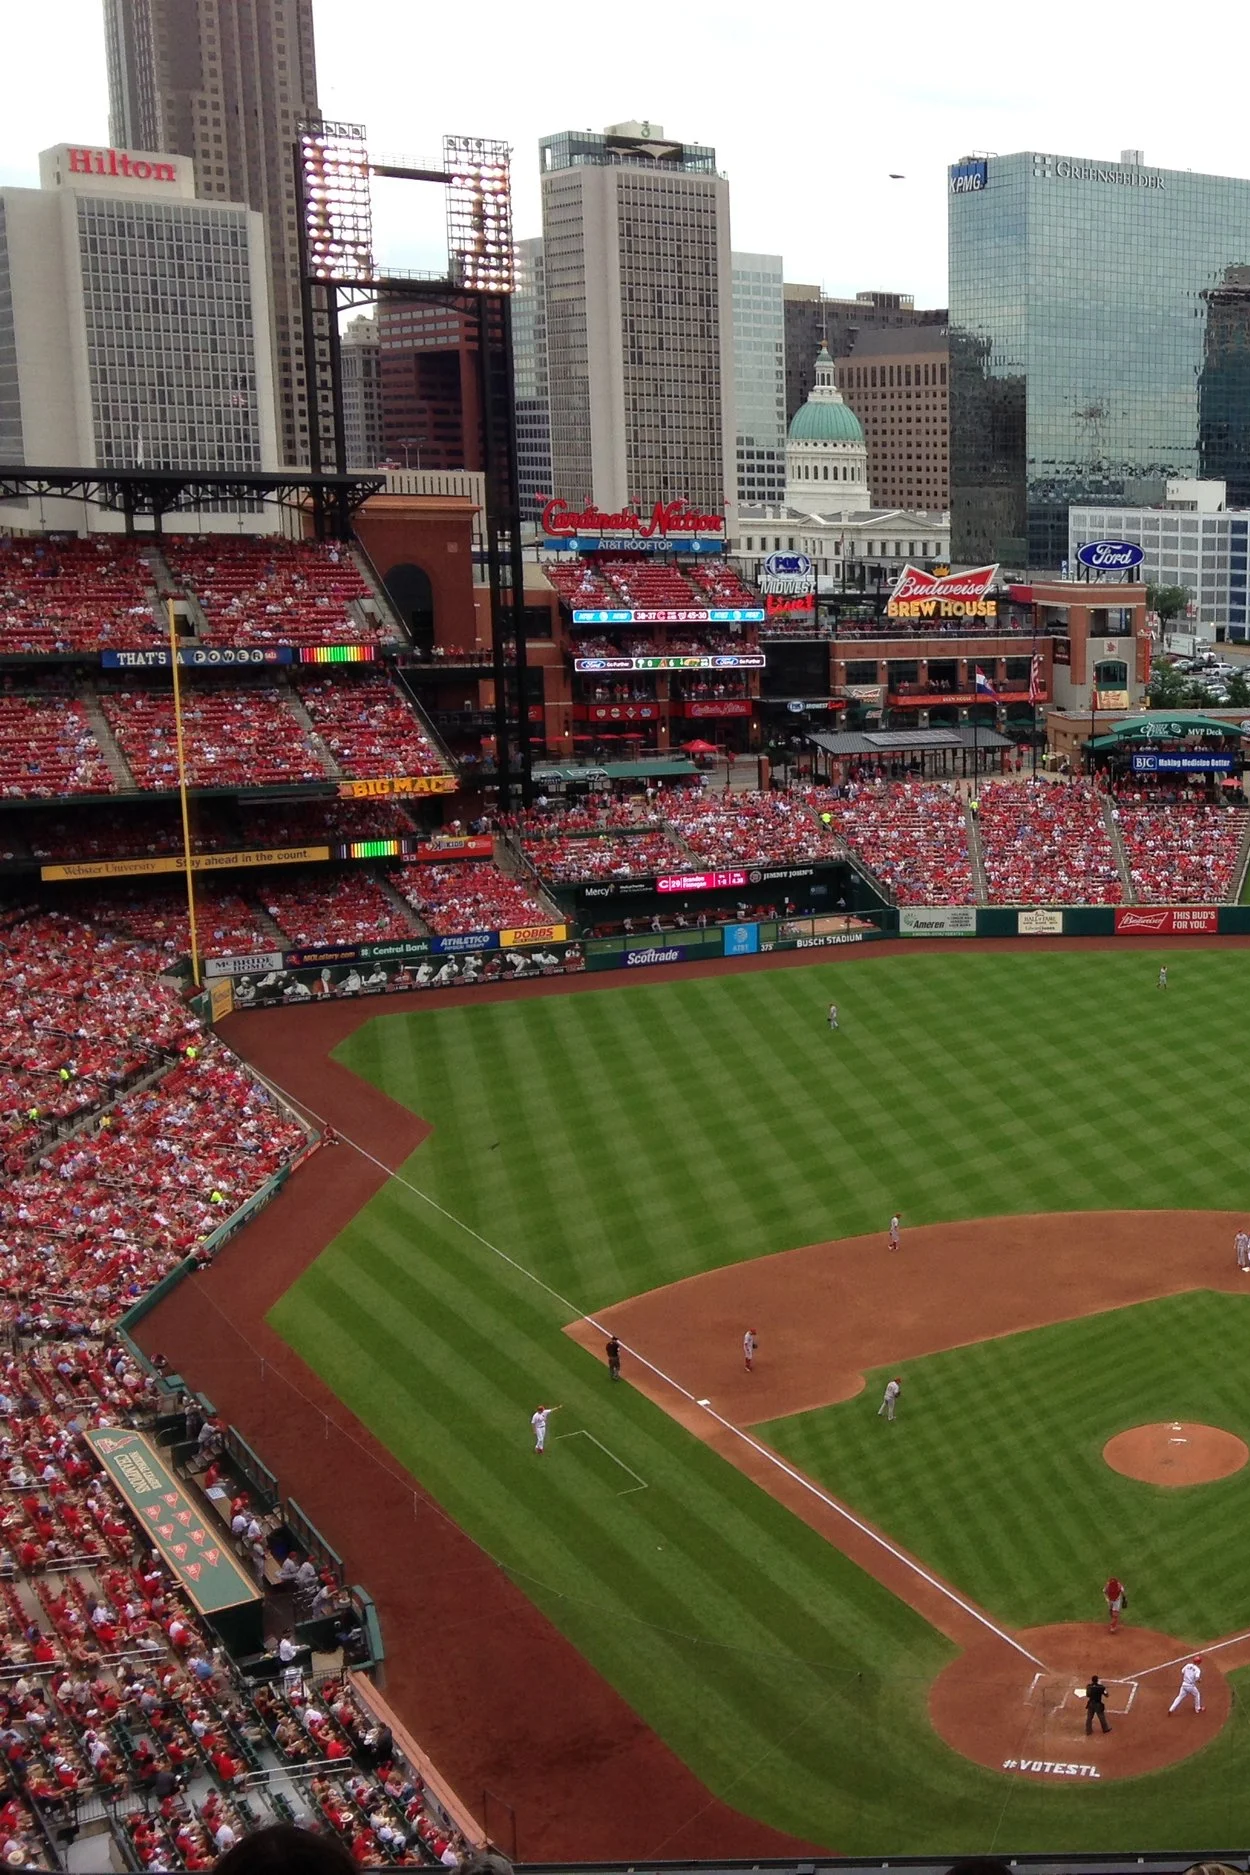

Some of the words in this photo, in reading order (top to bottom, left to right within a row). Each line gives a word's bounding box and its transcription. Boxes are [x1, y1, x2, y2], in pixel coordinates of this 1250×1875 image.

[67, 148, 176, 182] Hilton
[949, 173, 982, 193] KPMG
[542, 498, 641, 536] Cardinals
[640, 500, 723, 537] Nation
[598, 541, 622, 550] AT&T
[624, 540, 673, 550] ROOFTOP
[1092, 543, 1132, 565] Ford
[775, 556, 801, 568] FOX
[758, 580, 816, 594] MIDWEST
[887, 576, 995, 598] Budweiser
[888, 601, 937, 617] BREW
[941, 600, 997, 617] HOUSE
[116, 651, 167, 666] THAT'S
[1135, 758, 1154, 769] BJC
[1158, 759, 1181, 767] Making
[1181, 758, 1210, 767] Medicine
[1210, 759, 1231, 767] Better
[352, 779, 390, 798] BIG
[393, 776, 444, 794] MAC
[204, 855, 239, 866] ahead
[241, 854, 252, 862] in
[255, 853, 273, 862] the
[275, 849, 312, 860] count.
[62, 864, 103, 876] Webster
[104, 861, 157, 874] University
[763, 871, 788, 880] JIMMY
[789, 869, 814, 878] JOHN'S
[585, 888, 610, 897] Mercy
[1121, 914, 1164, 925] Budweiser
[1172, 911, 1191, 920] THIS
[1191, 911, 1216, 919] BUD'S
[913, 919, 945, 929] Ameren
[1172, 921, 1187, 929] FOR
[1188, 920, 1208, 929] YOU.
[440, 934, 490, 946] ATHLETICO
[513, 927, 554, 940] DOBBS
[796, 936, 824, 948] BUSCH
[826, 933, 863, 946] STADIUM
[372, 944, 404, 956] Central
[405, 942, 429, 953] Bank
[732, 943, 750, 951] AT&T
[760, 942, 773, 951] 375
[626, 948, 680, 966] Scottrade
[113, 1453, 152, 1494] CHAMPIONS
[1001, 1758, 1101, 1779] #VOTESTL
